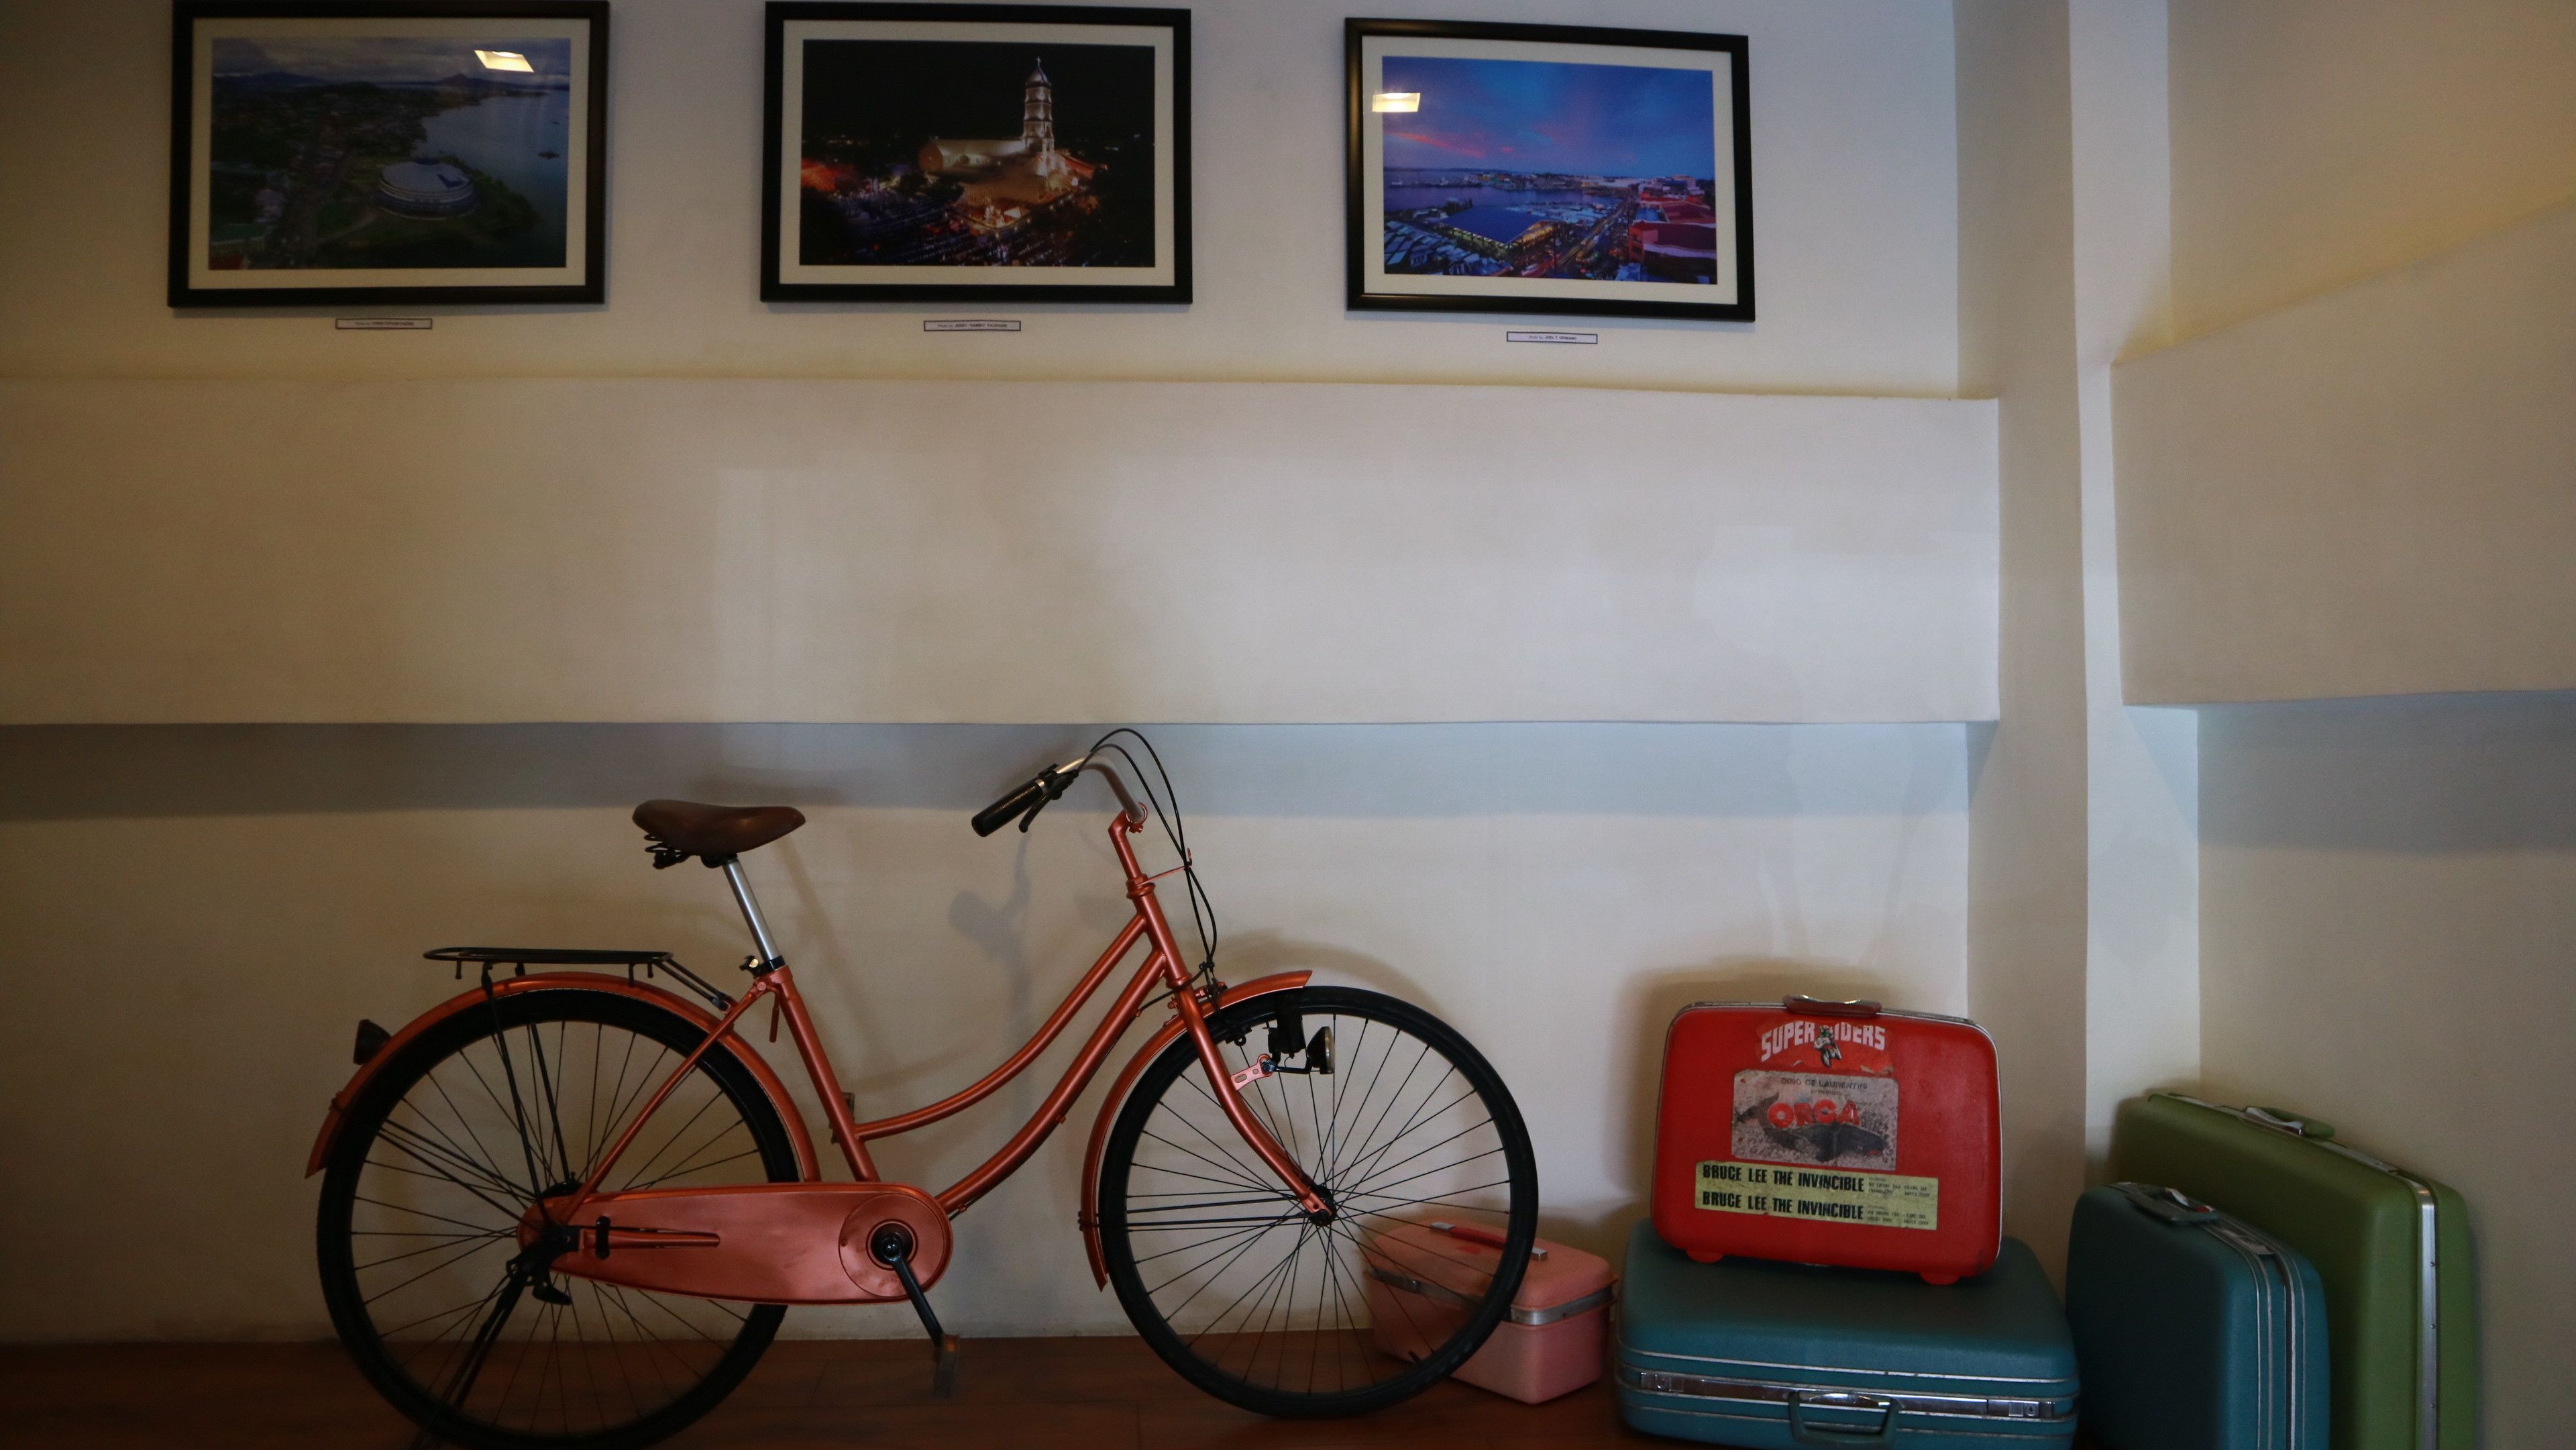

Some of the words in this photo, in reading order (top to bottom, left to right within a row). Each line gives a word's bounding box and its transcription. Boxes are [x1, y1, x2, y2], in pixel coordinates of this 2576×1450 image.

[1761, 1020, 1815, 1062] SUPER
[1833, 1021, 1886, 1051] IDERS
[1781, 1077, 1802, 1086] DINO
[1805, 1078, 1816, 1087] DE
[1767, 1099, 1860, 1129] ORCA
[1703, 1164, 1742, 1181] BRUCE
[1748, 1168, 1768, 1183] LEE
[1773, 1170, 1793, 1186] THE
[1798, 1172, 1864, 1192] INVINCIBLE
[1703, 1191, 1741, 1208] BRUCE
[1748, 1196, 1767, 1210] LEE
[1772, 1198, 1792, 1213] THE
[1797, 1200, 1864, 1219] INVINCIBLE
